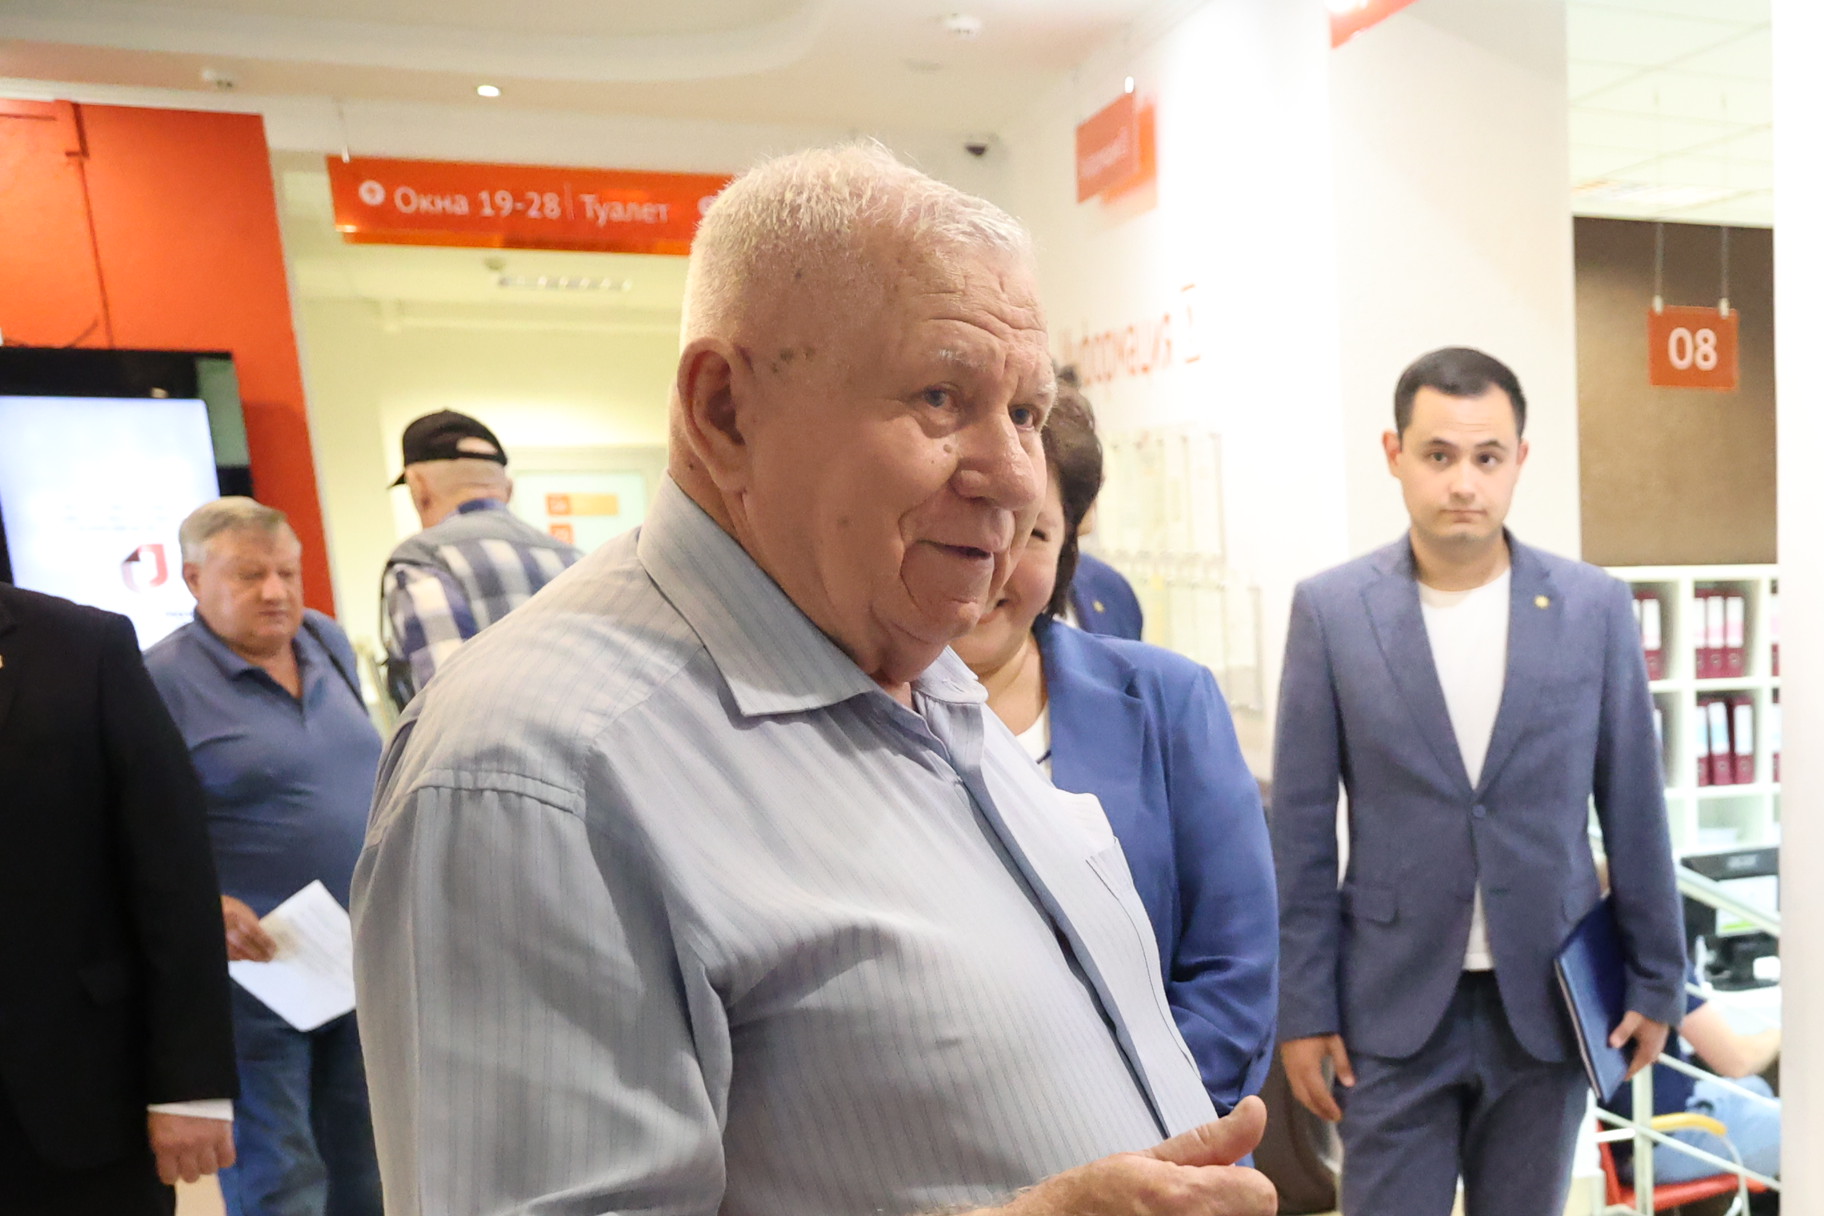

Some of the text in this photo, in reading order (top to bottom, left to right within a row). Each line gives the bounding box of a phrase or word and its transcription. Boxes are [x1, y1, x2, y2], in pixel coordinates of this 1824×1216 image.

[395, 186, 669, 227] Окна 19-28 Туалет
[1668, 327, 1718, 371] 08
